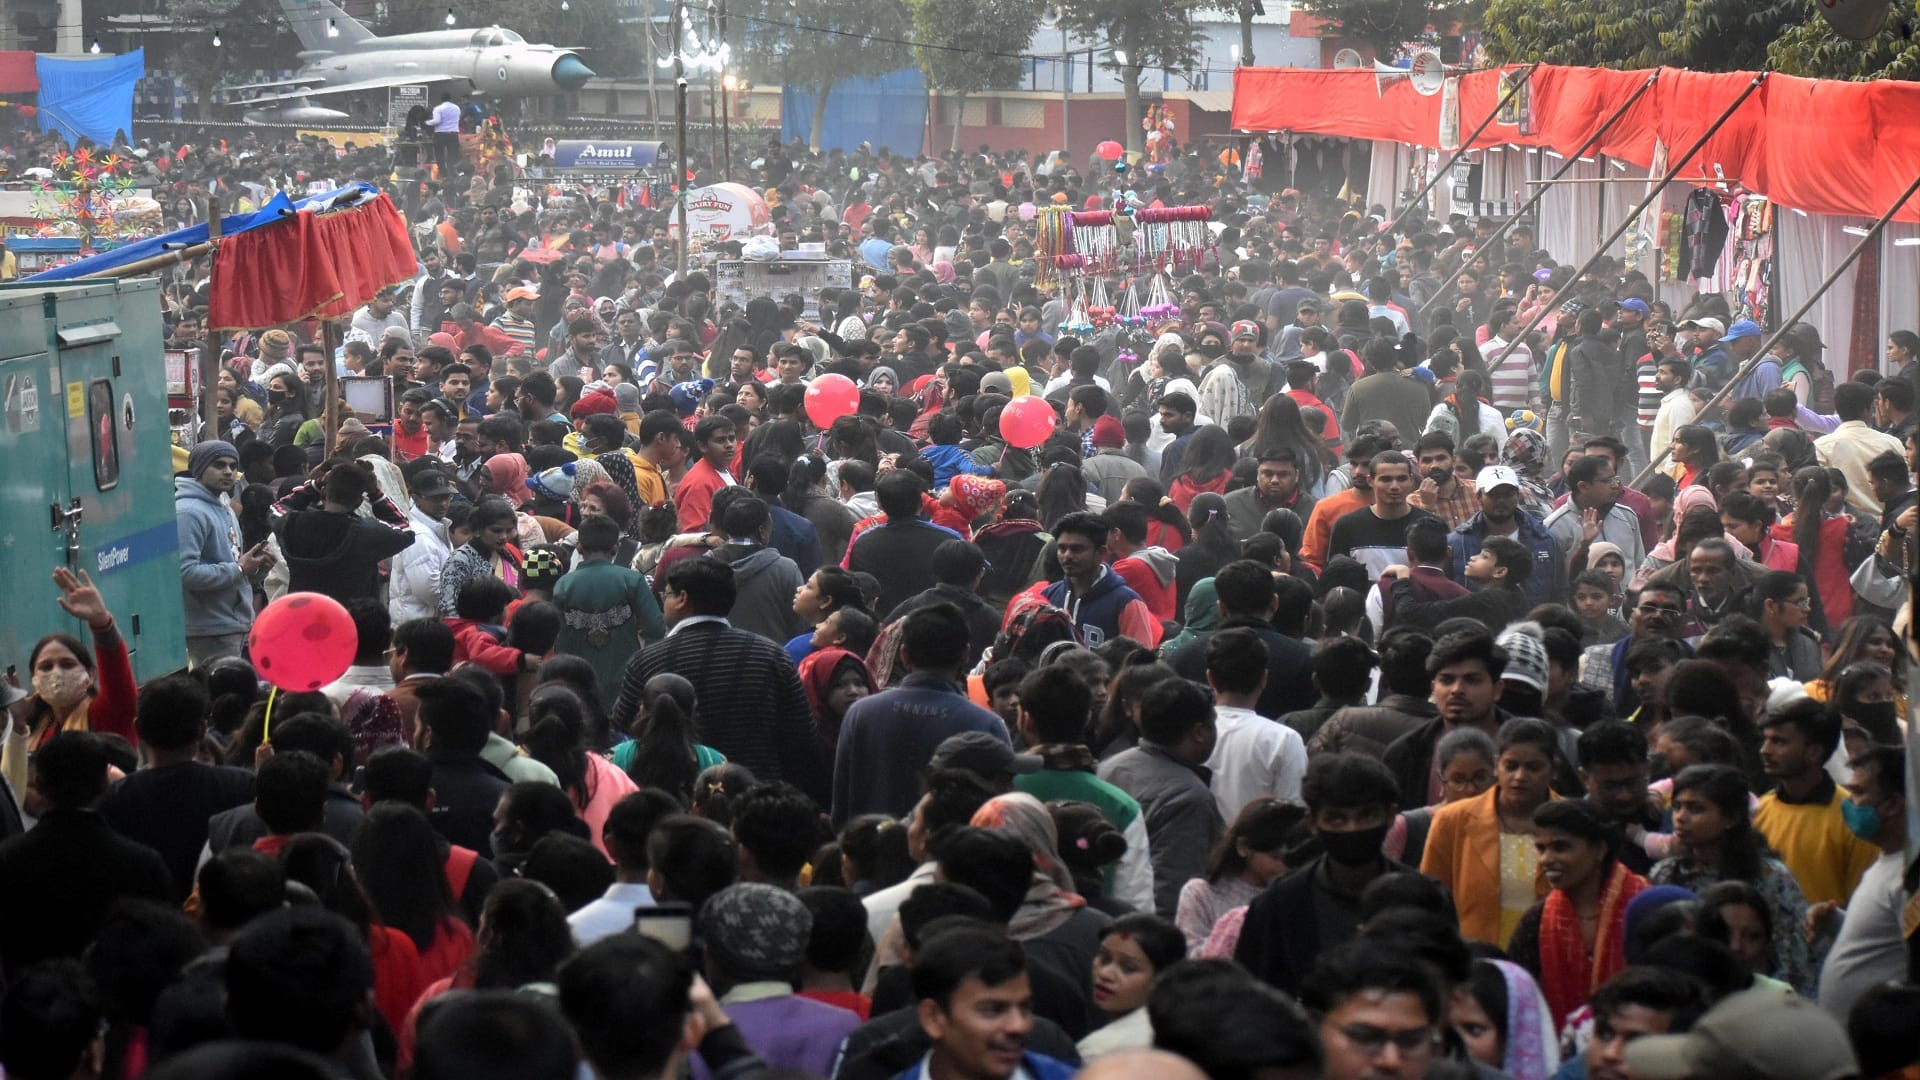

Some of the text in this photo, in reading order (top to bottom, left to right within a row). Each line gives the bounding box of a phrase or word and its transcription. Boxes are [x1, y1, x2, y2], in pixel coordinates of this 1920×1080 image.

[579, 144, 633, 158] Amul
[714, 202, 730, 211] FUN
[97, 546, 129, 571] SilentPower
